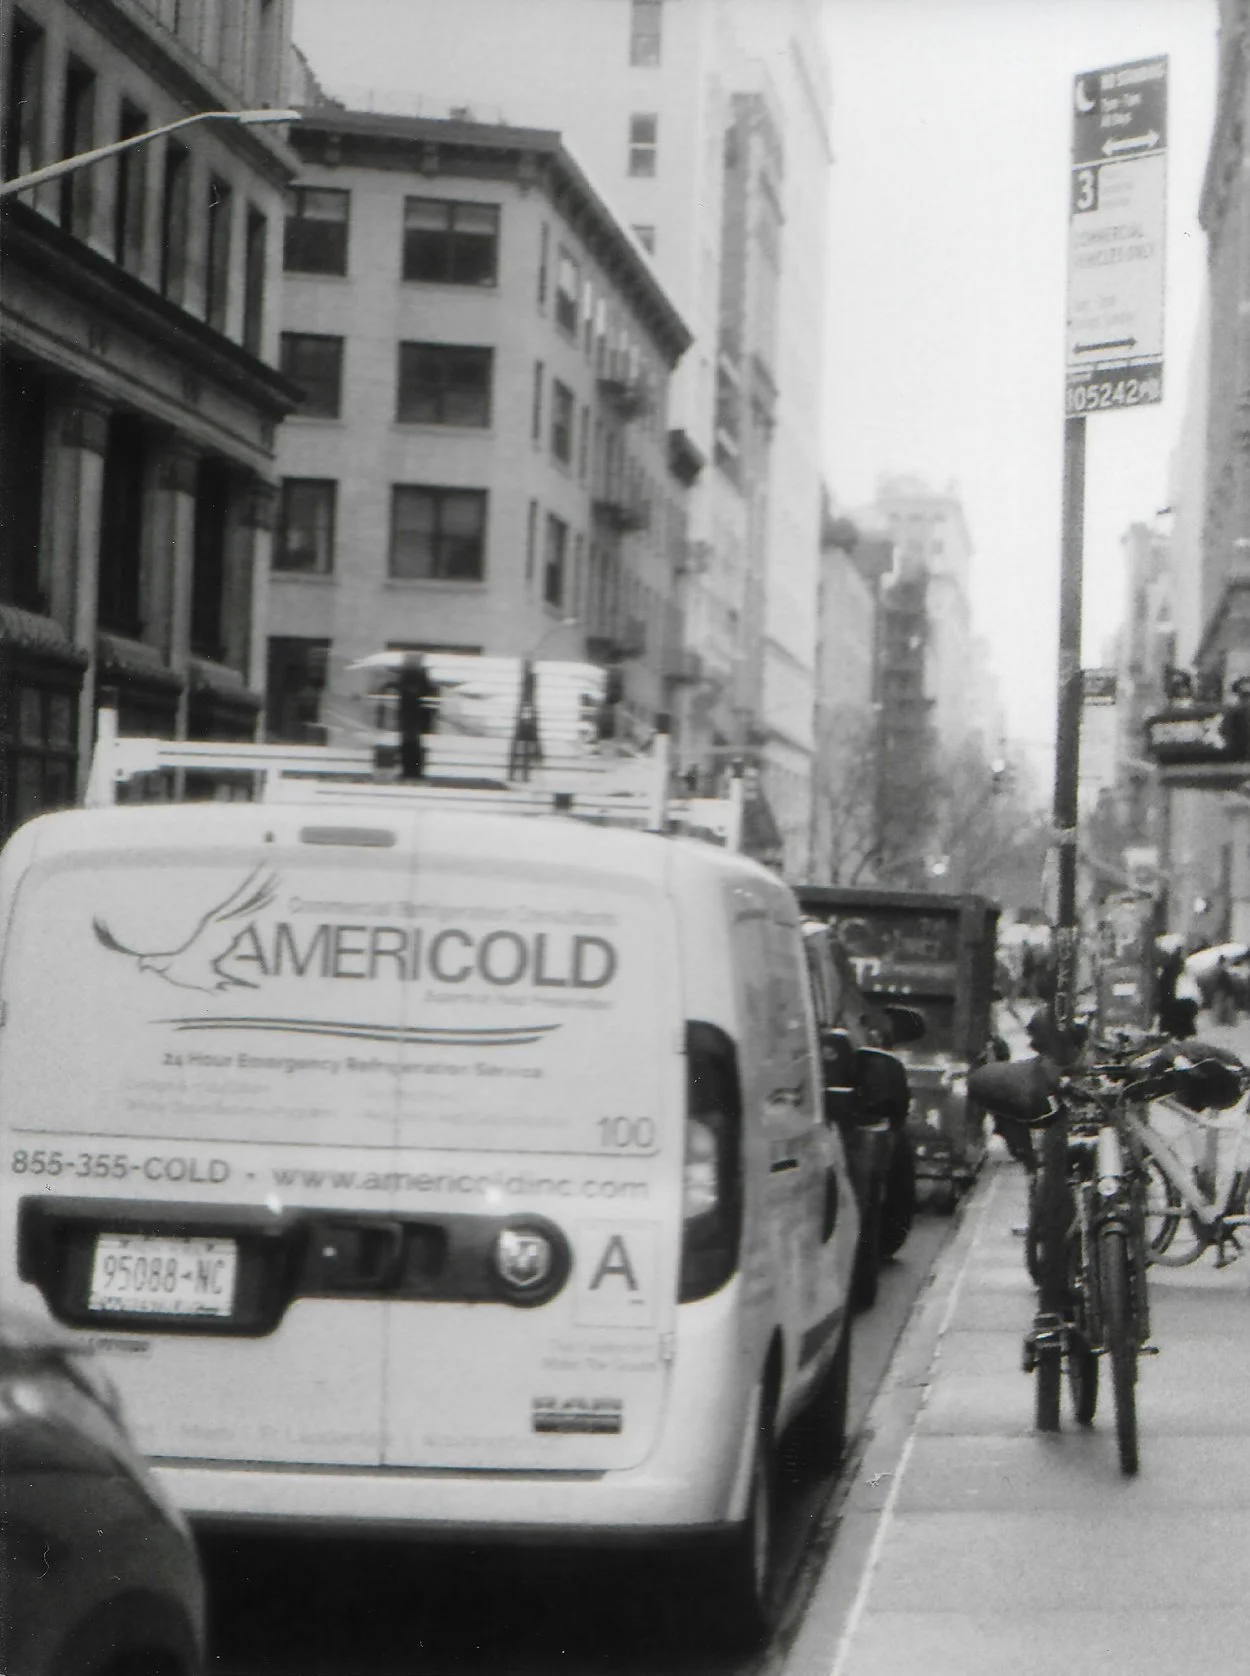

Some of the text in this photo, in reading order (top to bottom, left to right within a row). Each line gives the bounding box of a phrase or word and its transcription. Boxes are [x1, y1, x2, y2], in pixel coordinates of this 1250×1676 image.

[1076, 169, 1094, 210] 3
[209, 921, 618, 991] AMERICOLD
[598, 1116, 656, 1148] 100
[10, 1149, 231, 1183] 855-355-COLD
[588, 1235, 640, 1291] A
